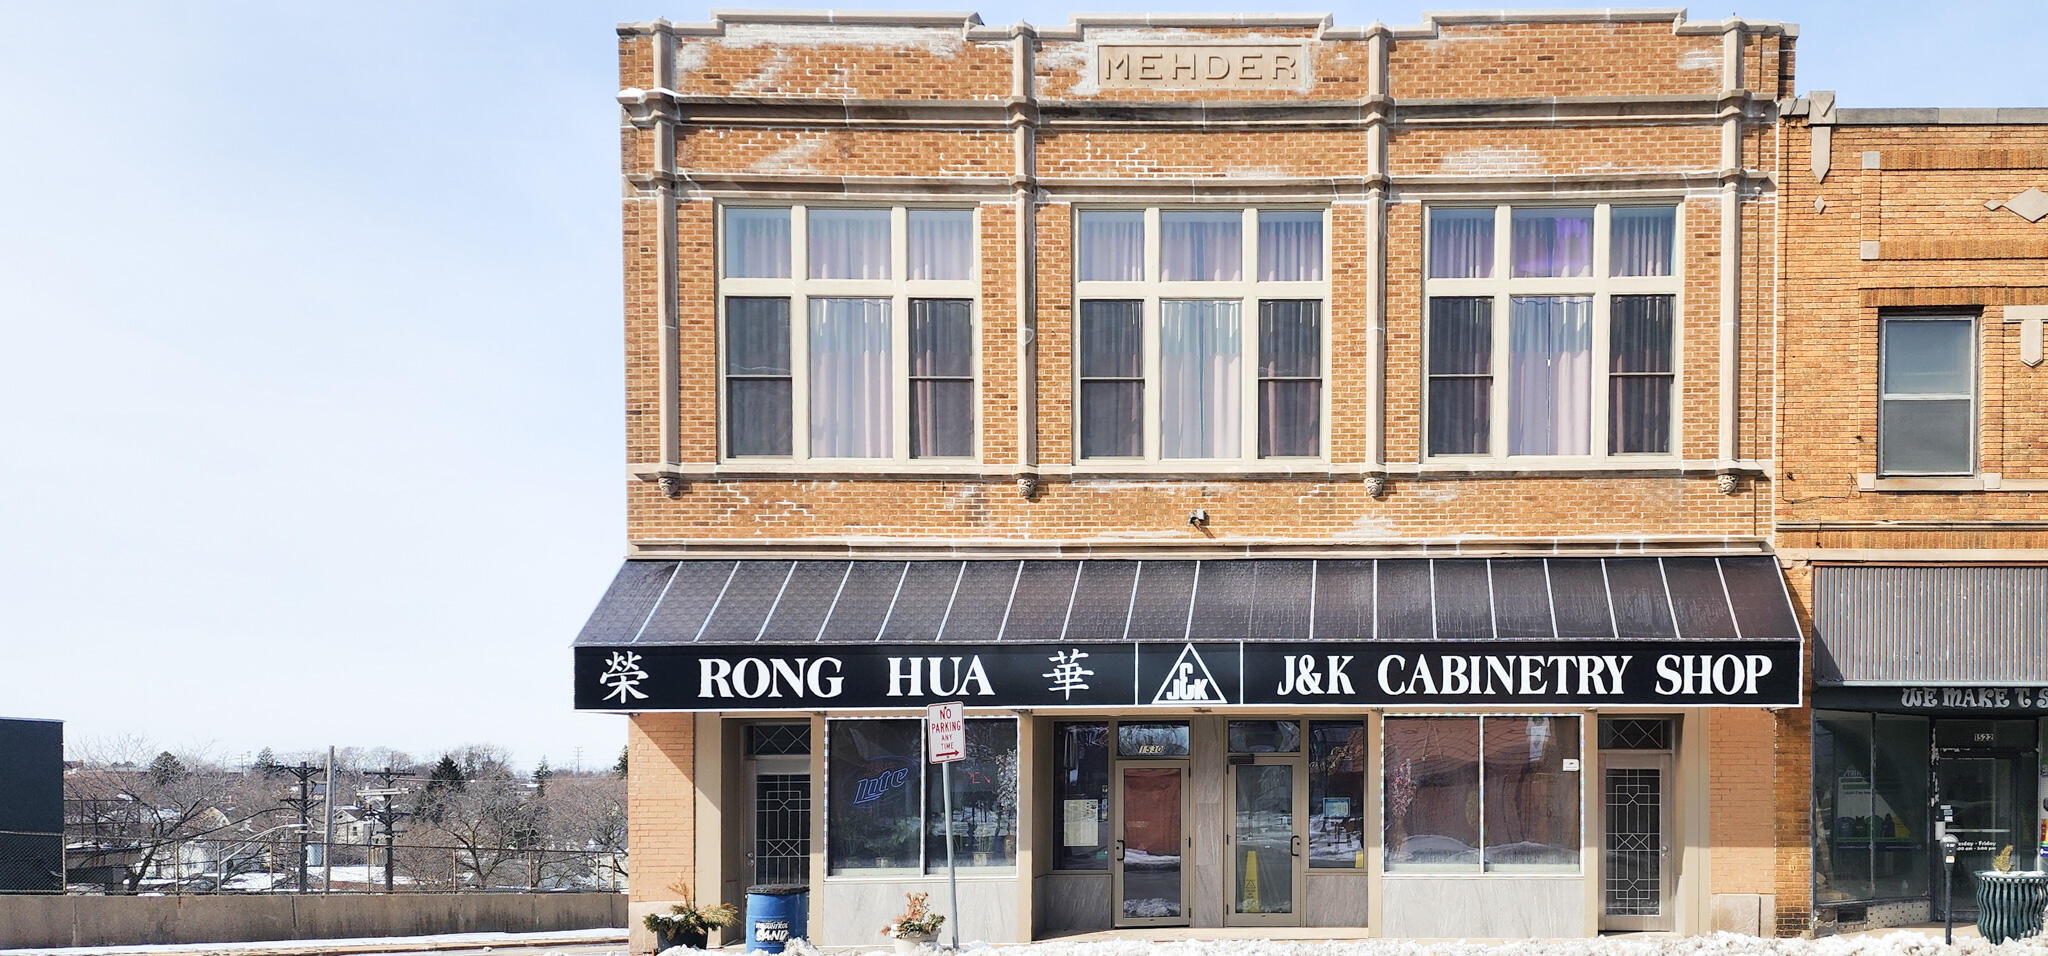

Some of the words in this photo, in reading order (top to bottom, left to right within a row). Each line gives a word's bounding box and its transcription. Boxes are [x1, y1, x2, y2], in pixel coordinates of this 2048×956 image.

[1105, 53, 1297, 80] MEHDER
[600, 651, 648, 703] 榮
[698, 656, 844, 698] RONG
[887, 655, 995, 697] HUA
[1043, 649, 1094, 700] 華
[1166, 662, 1209, 700] J&K
[1277, 655, 1355, 695] J&K
[1378, 654, 1632, 696] CABINETRY
[1655, 655, 1772, 696] SHOP
[1901, 688, 1938, 708] WE
[1942, 688, 2010, 708] MAKE
[2015, 688, 2032, 708] T
[939, 708, 952, 720] NO
[931, 720, 961, 733] PARKING
[941, 742, 954, 751] TIME
[1139, 745, 1164, 753] 1530
[756, 929, 788, 942] SAND
